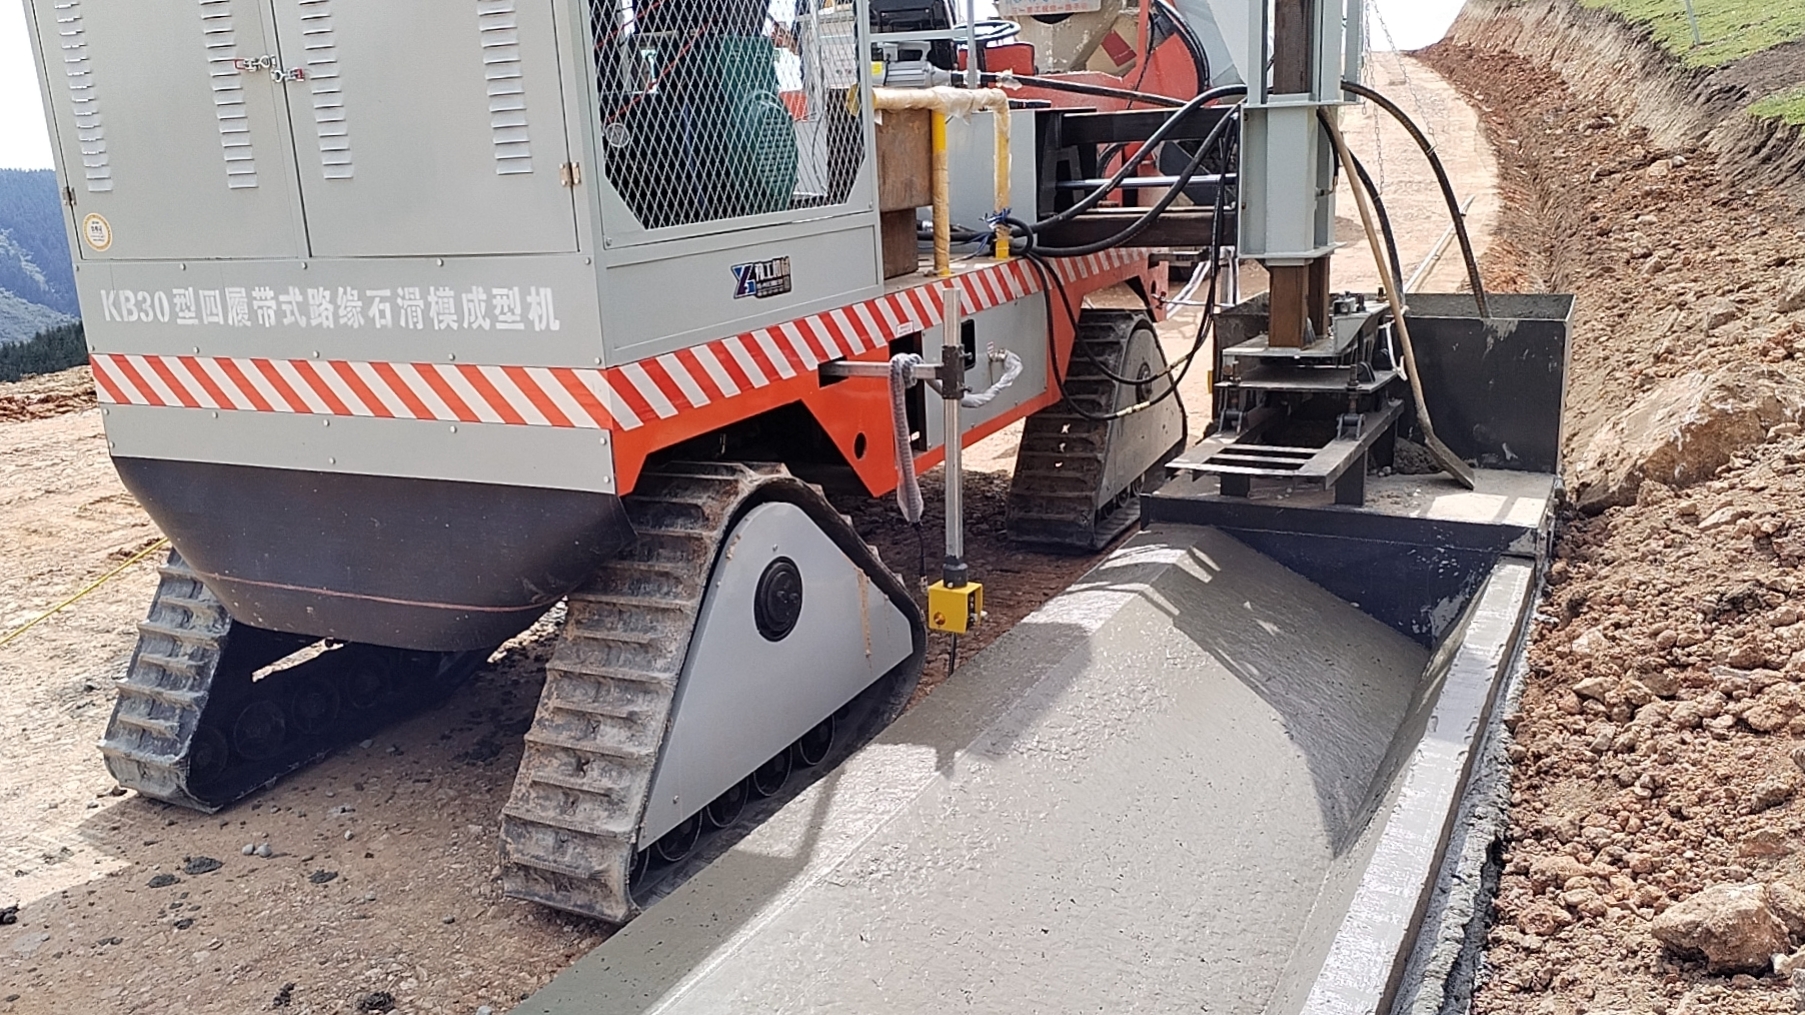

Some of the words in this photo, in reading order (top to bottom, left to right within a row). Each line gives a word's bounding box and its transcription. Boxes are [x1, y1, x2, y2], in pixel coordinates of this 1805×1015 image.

[100, 285, 560, 332] KB30型四履带式路缘石滑模成型机
